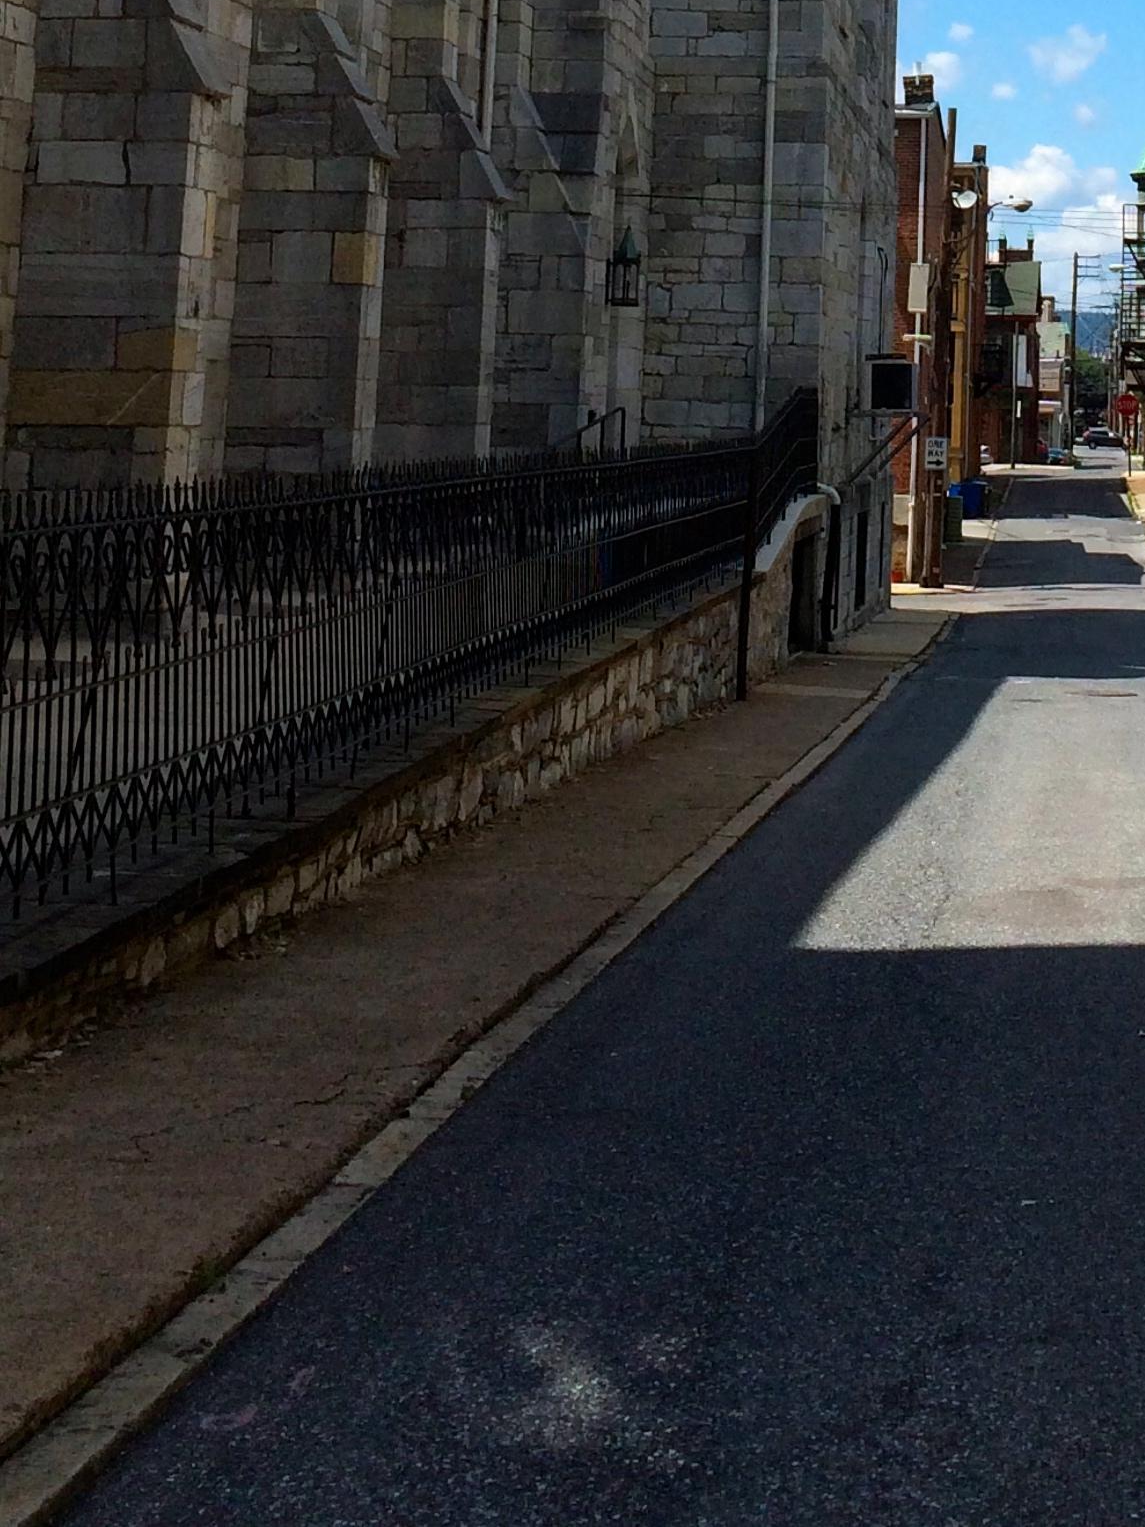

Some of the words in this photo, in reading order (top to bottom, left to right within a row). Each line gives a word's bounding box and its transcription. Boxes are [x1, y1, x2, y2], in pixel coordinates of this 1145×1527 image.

[1118, 400, 1136, 410] STOP
[927, 439, 944, 448] ONE
[927, 449, 944, 458] WAY
